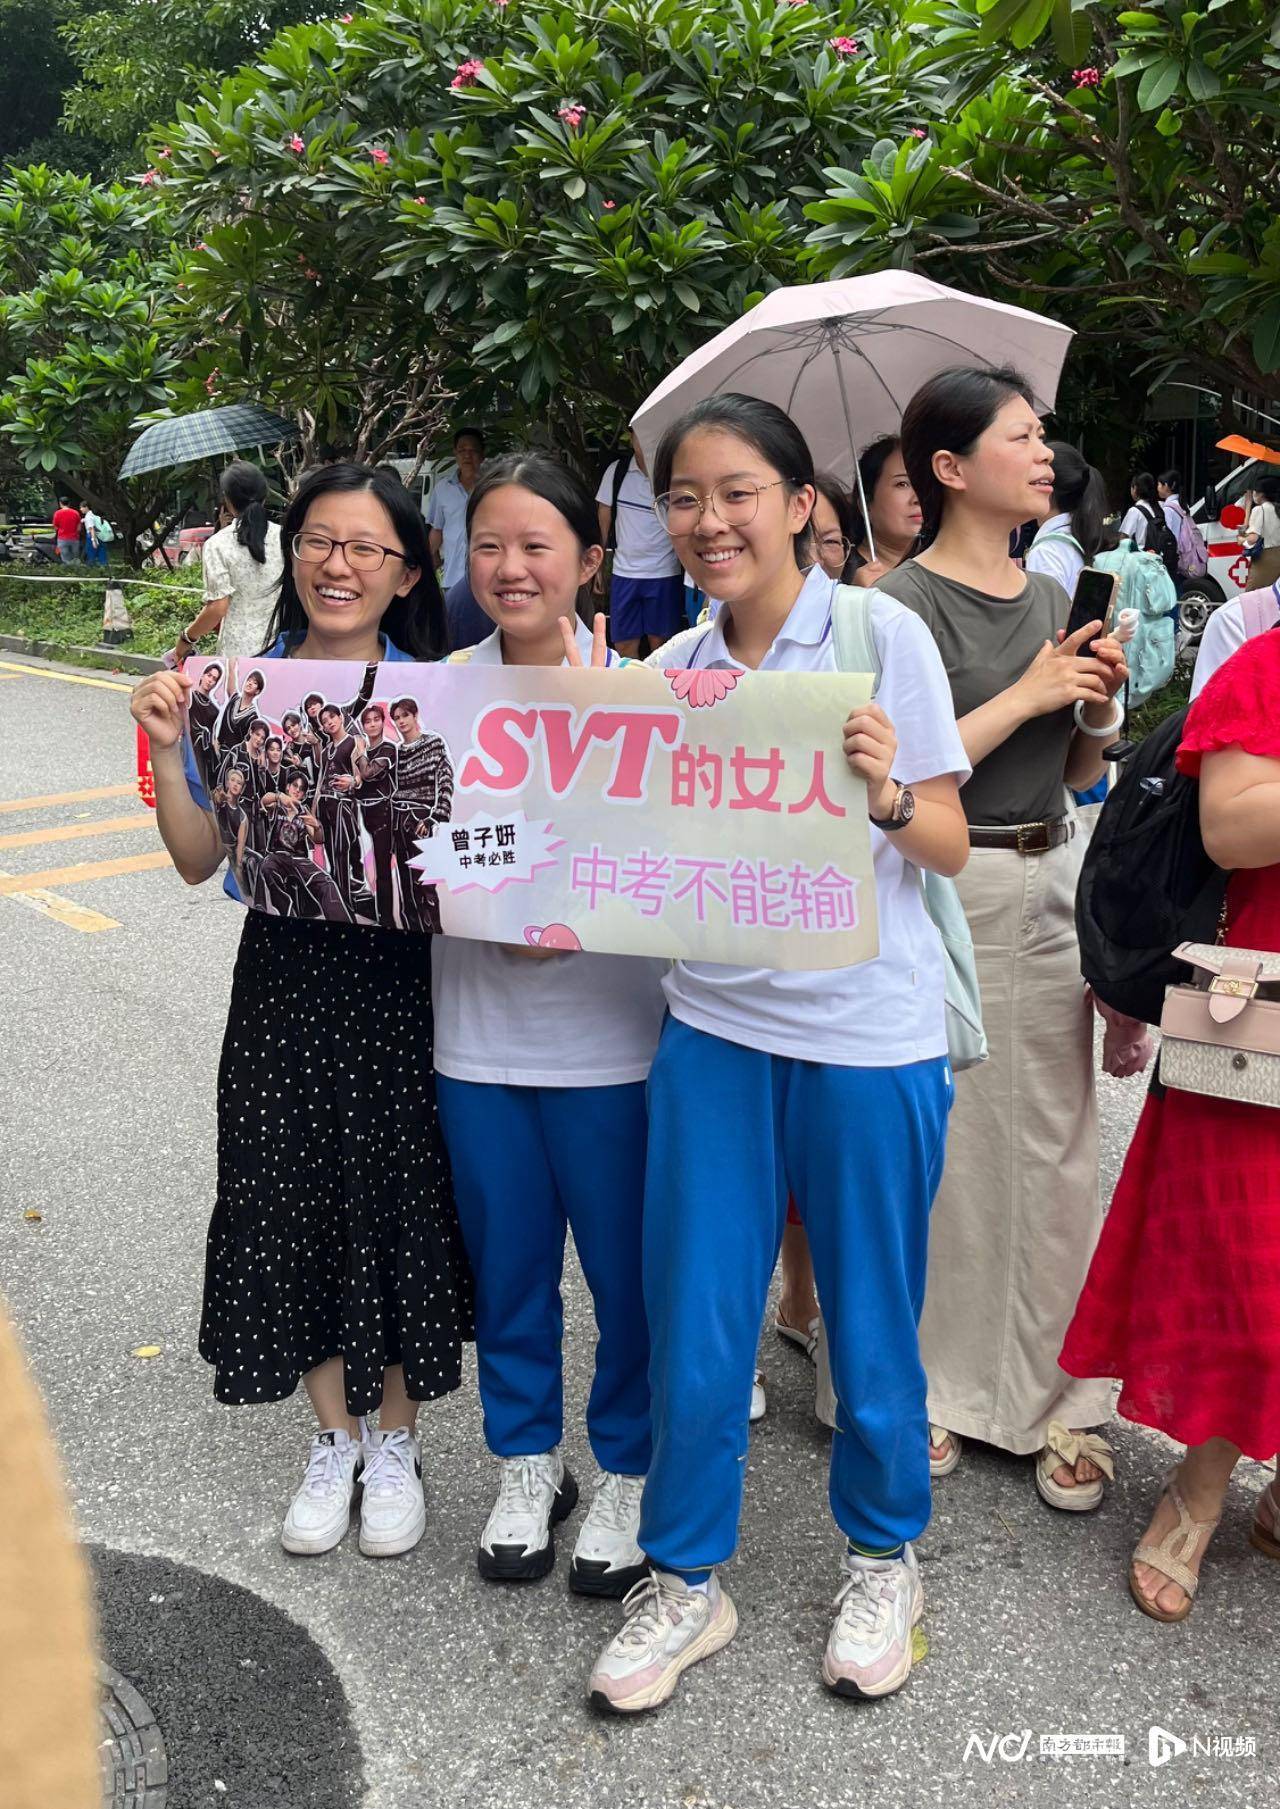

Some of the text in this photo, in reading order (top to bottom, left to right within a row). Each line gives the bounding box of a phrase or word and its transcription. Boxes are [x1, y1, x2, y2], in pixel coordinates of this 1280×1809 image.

[451, 824, 516, 851] 曾子妍
[459, 850, 516, 869] 中考必胜
[571, 844, 856, 931] 中考不能输
